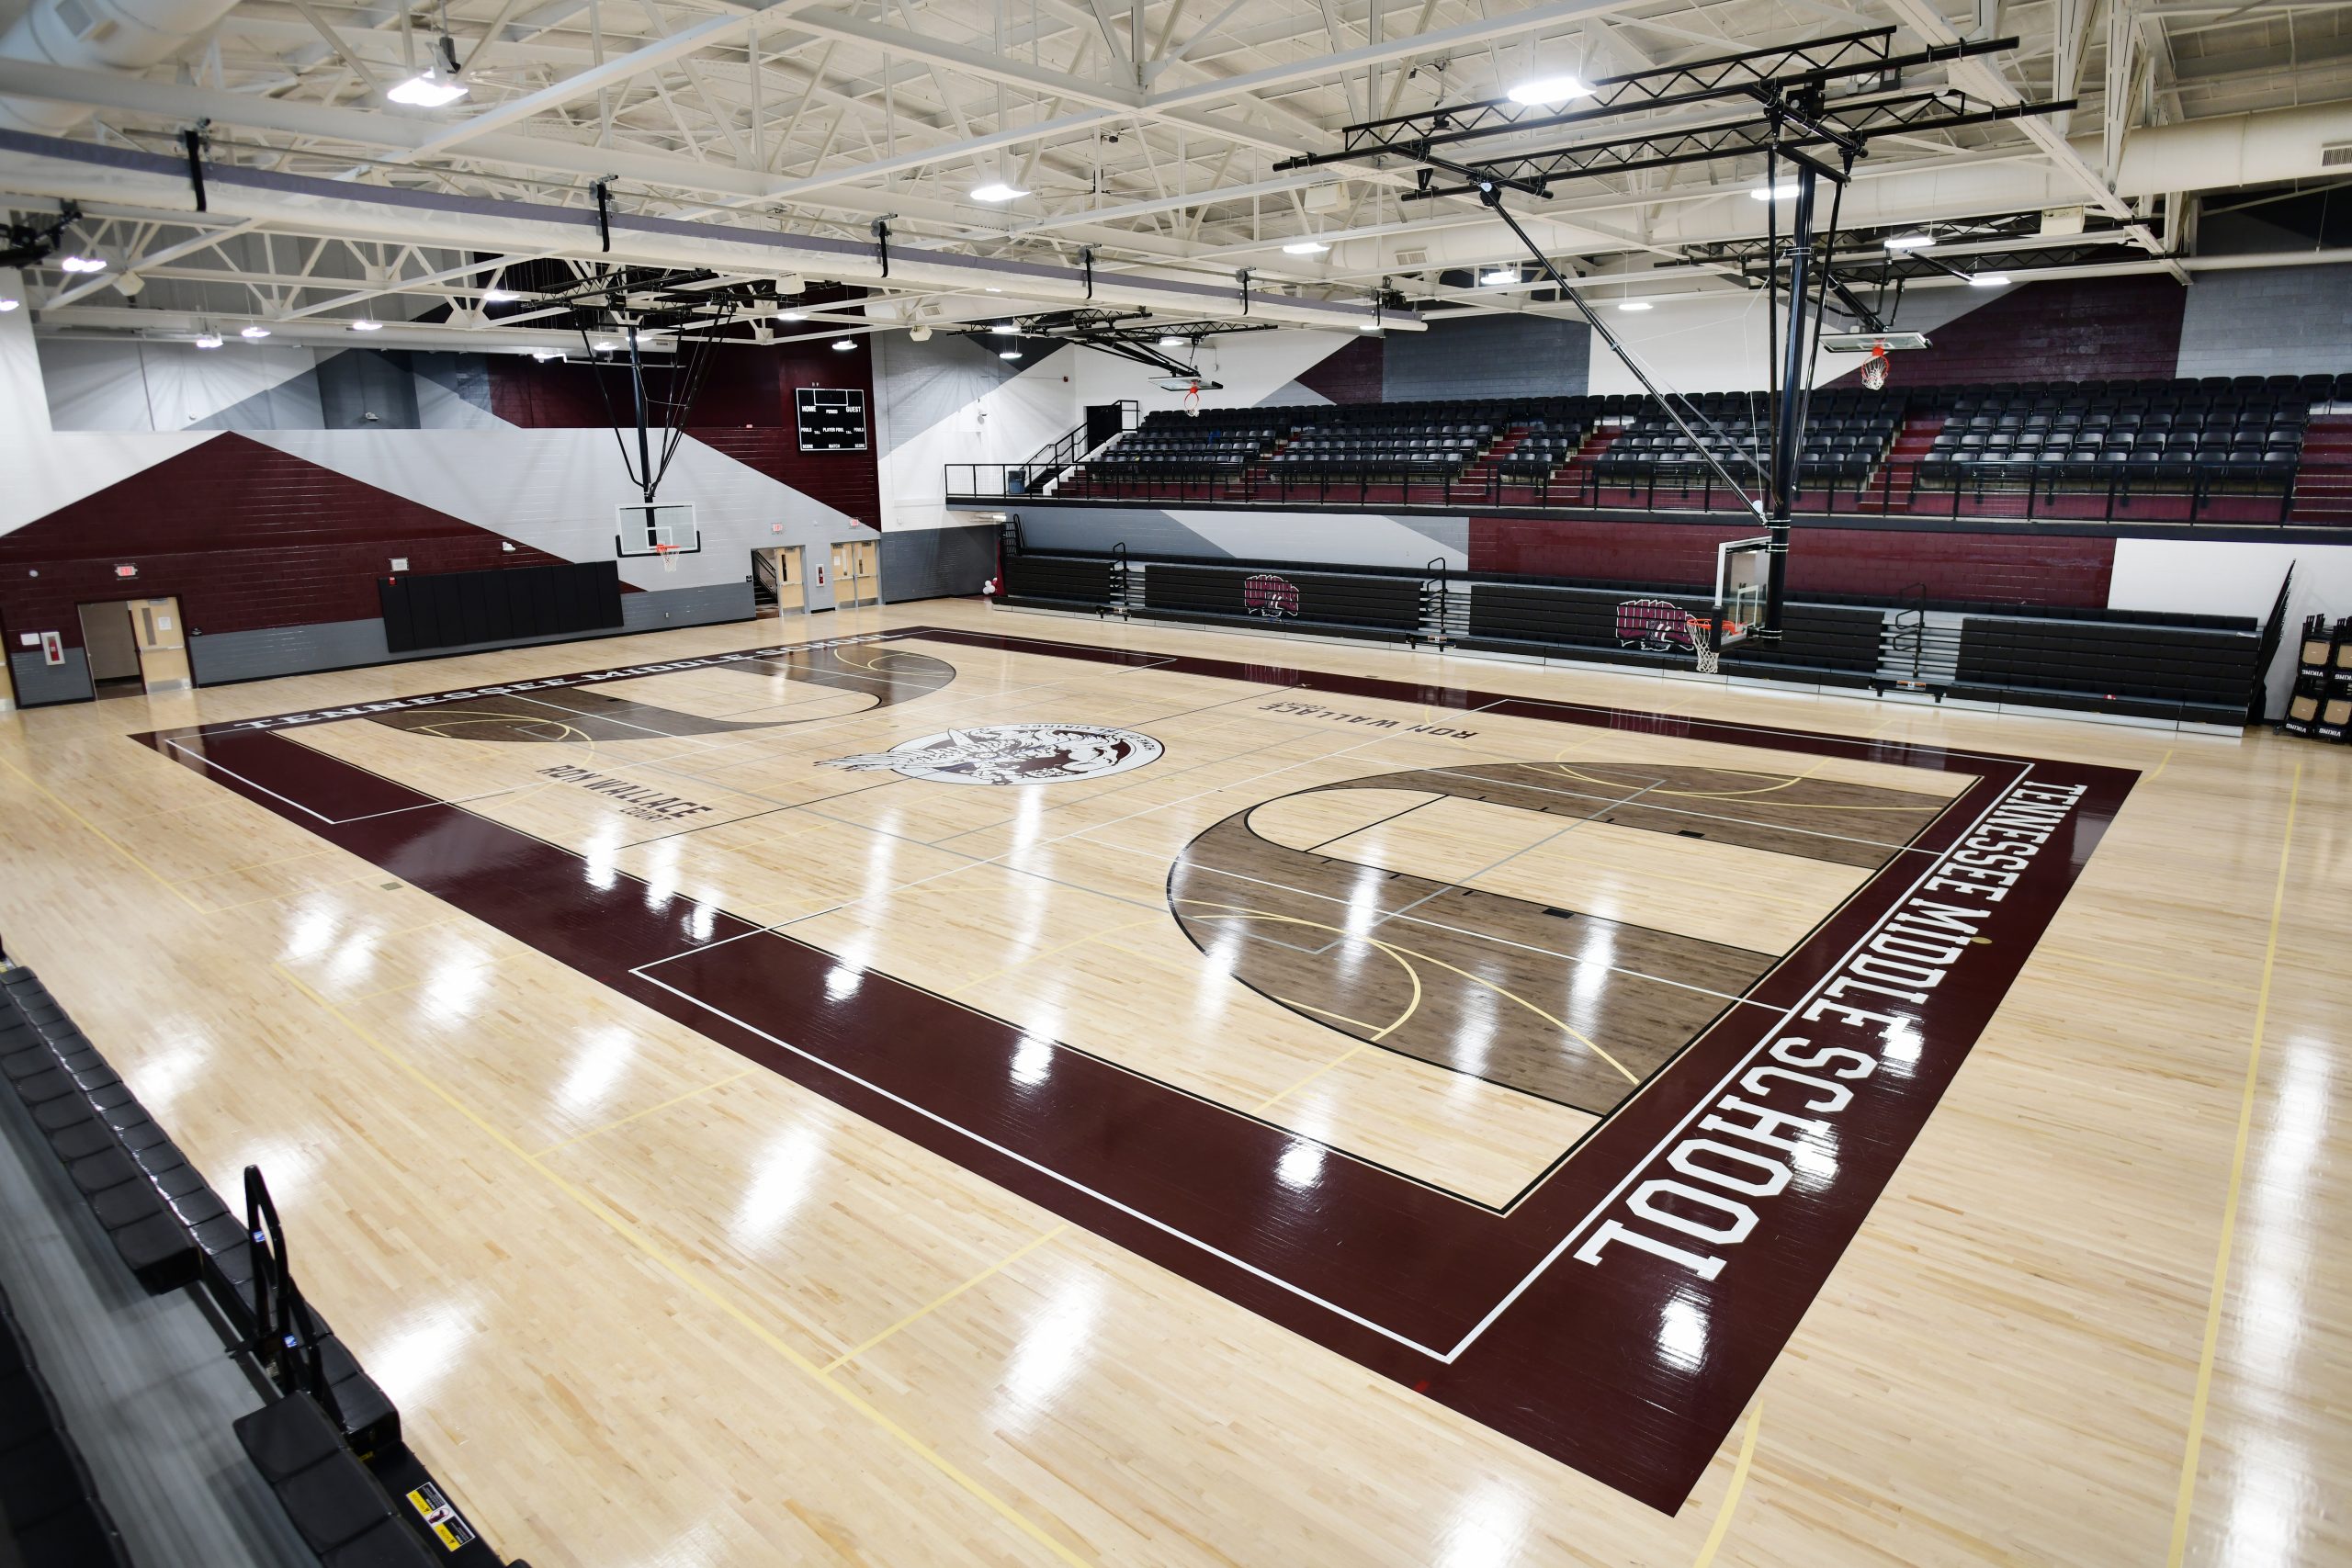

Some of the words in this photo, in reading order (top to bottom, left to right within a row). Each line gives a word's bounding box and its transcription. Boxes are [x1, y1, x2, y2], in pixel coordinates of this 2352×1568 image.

[234, 678, 564, 730] TENNESSEE
[580, 652, 743, 681] MIDDLE
[755, 633, 900, 657] SCHOOL
[2301, 669, 2324, 677] VIKING
[1282, 701, 1327, 710] COURT
[1258, 704, 1400, 728] WALLACE
[1406, 724, 1479, 739] RON
[2285, 723, 2307, 733] VIKING
[2318, 728, 2341, 738] VIKING
[536, 764, 603, 784] RON
[582, 778, 713, 818] WALLACE
[619, 807, 673, 823] COURT
[1923, 781, 2088, 902] TENNESSEE
[1801, 897, 1992, 1040] MIDDLE
[1573, 1037, 1879, 1280] SCHOOL
